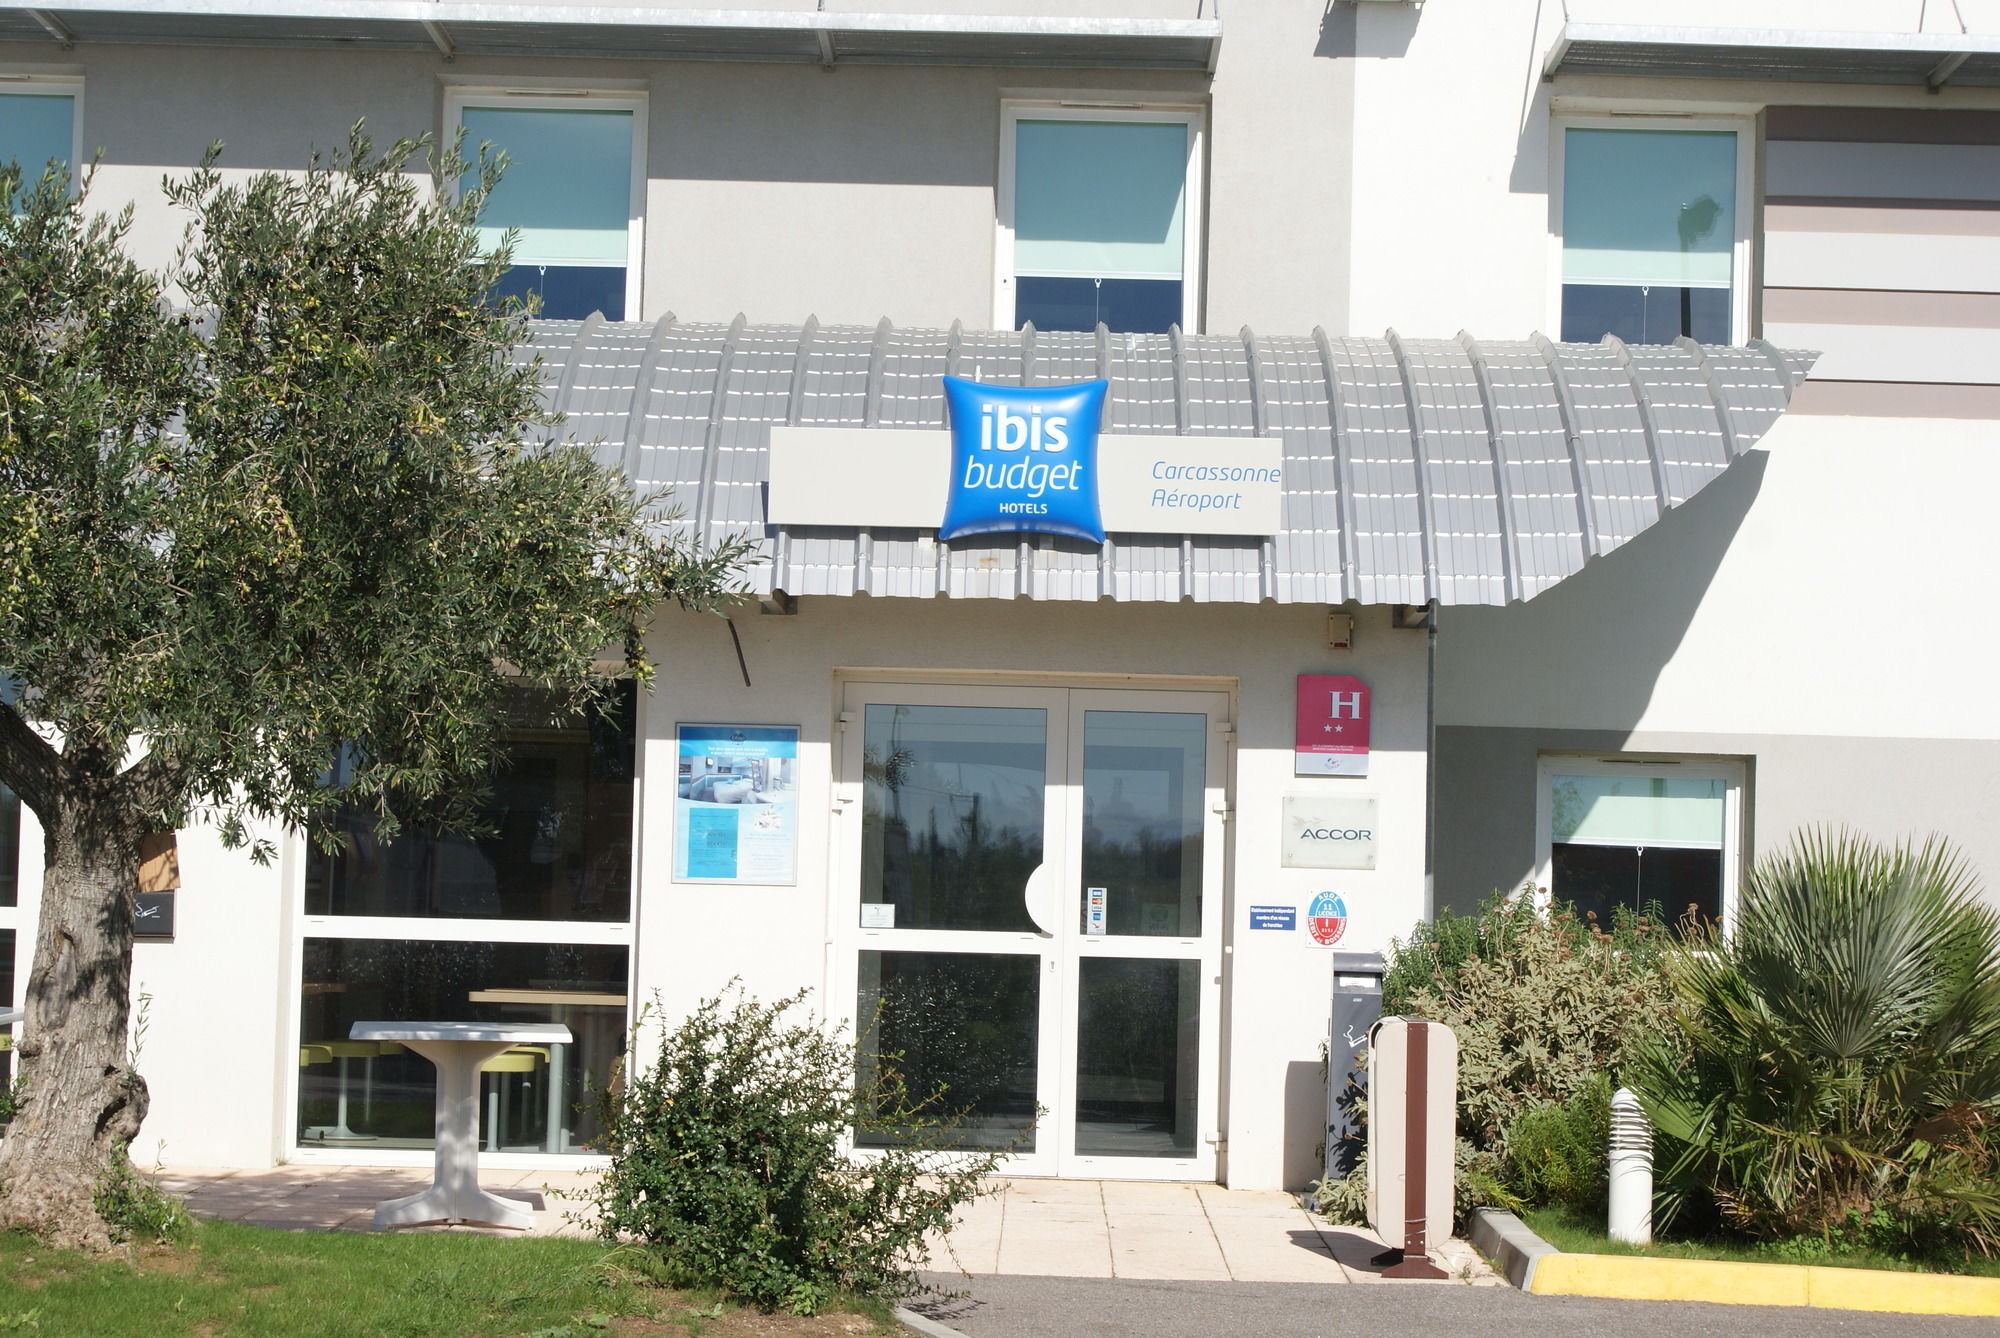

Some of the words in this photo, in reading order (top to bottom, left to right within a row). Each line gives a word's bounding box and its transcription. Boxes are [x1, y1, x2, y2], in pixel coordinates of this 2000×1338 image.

[981, 404, 1069, 453] ibis
[964, 455, 1083, 498] budget
[1152, 461, 1280, 482] Carcassonne
[999, 503, 1048, 514] HOTELS
[1152, 488, 1242, 512] Aéroport
[1328, 691, 1363, 719] H
[1300, 828, 1371, 840] ACCOR
[1318, 892, 1340, 902] AUDE
[1323, 903, 1332, 911] 11
